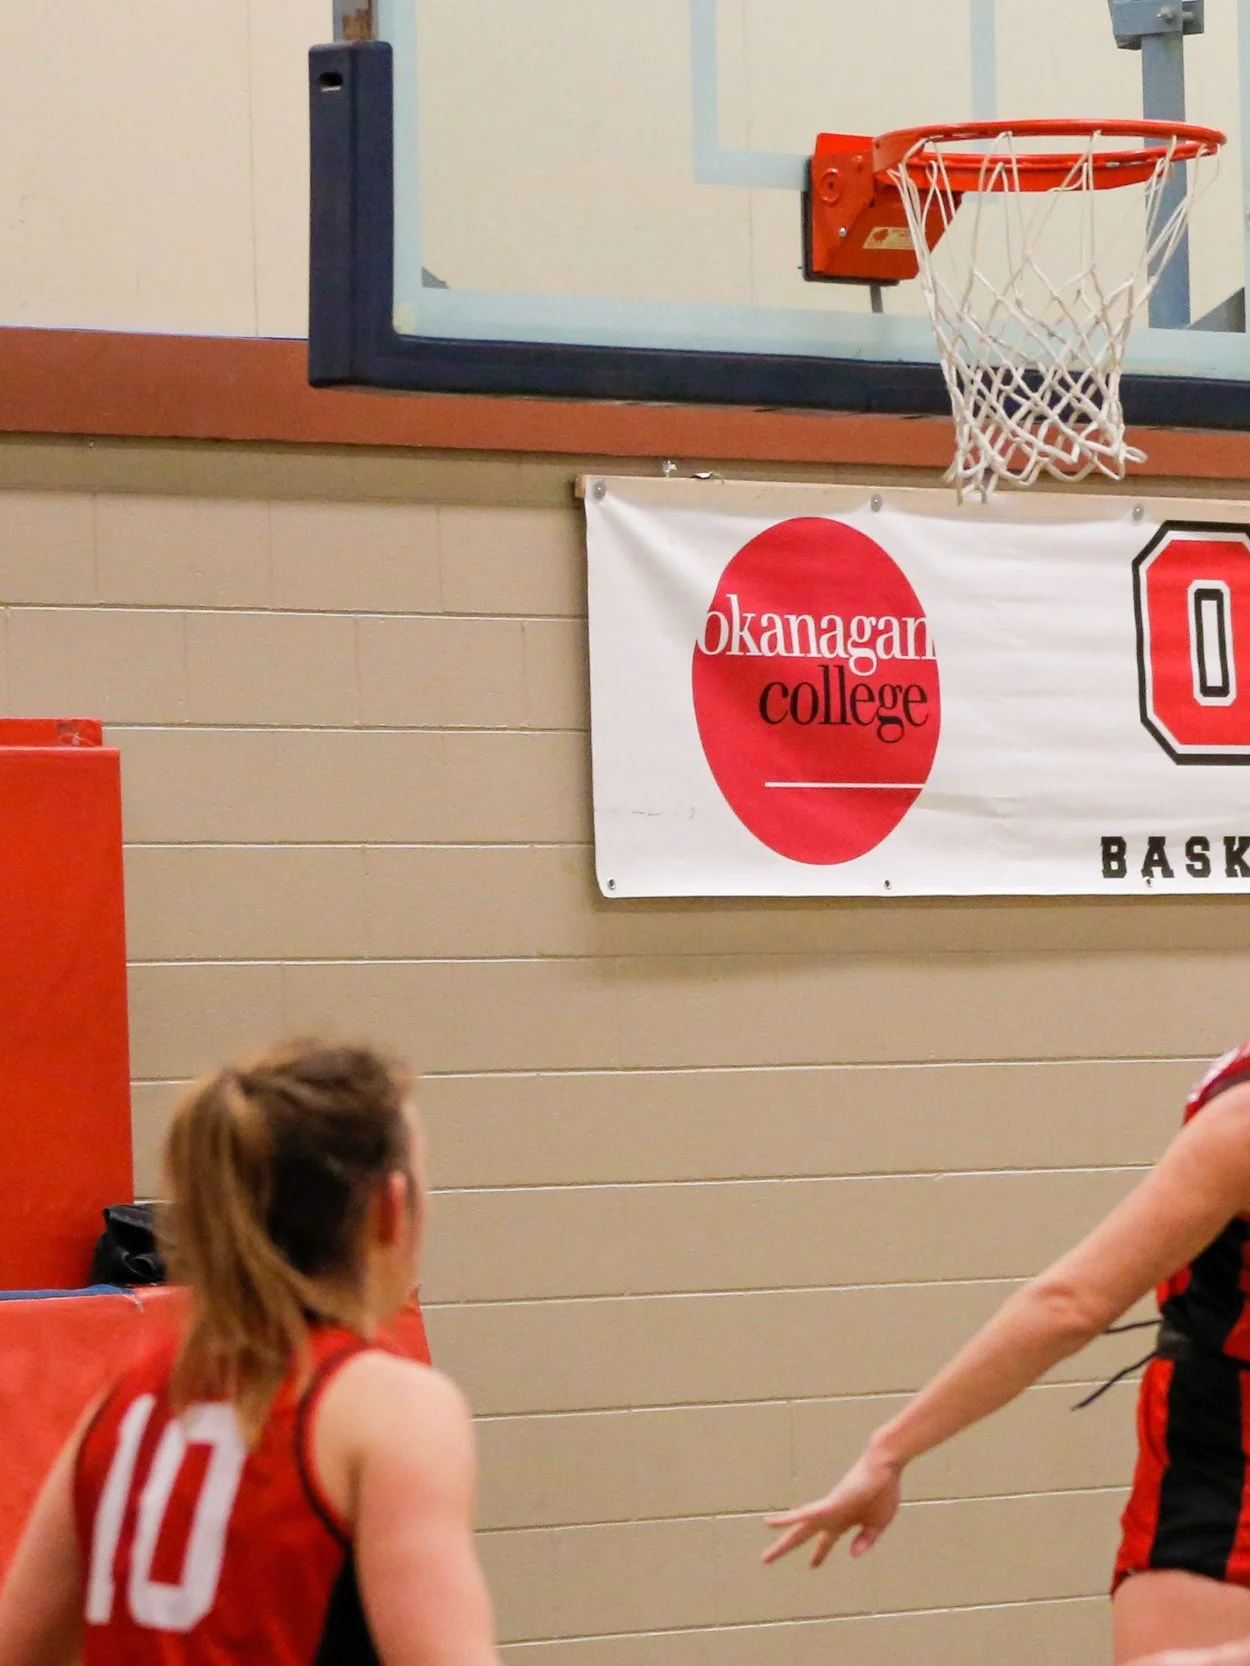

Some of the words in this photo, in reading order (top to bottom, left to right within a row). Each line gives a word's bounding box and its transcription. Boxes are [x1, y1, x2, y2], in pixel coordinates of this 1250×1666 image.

[697, 593, 937, 677] okanagan
[759, 665, 930, 744] college
[86, 1394, 249, 1633] 10
